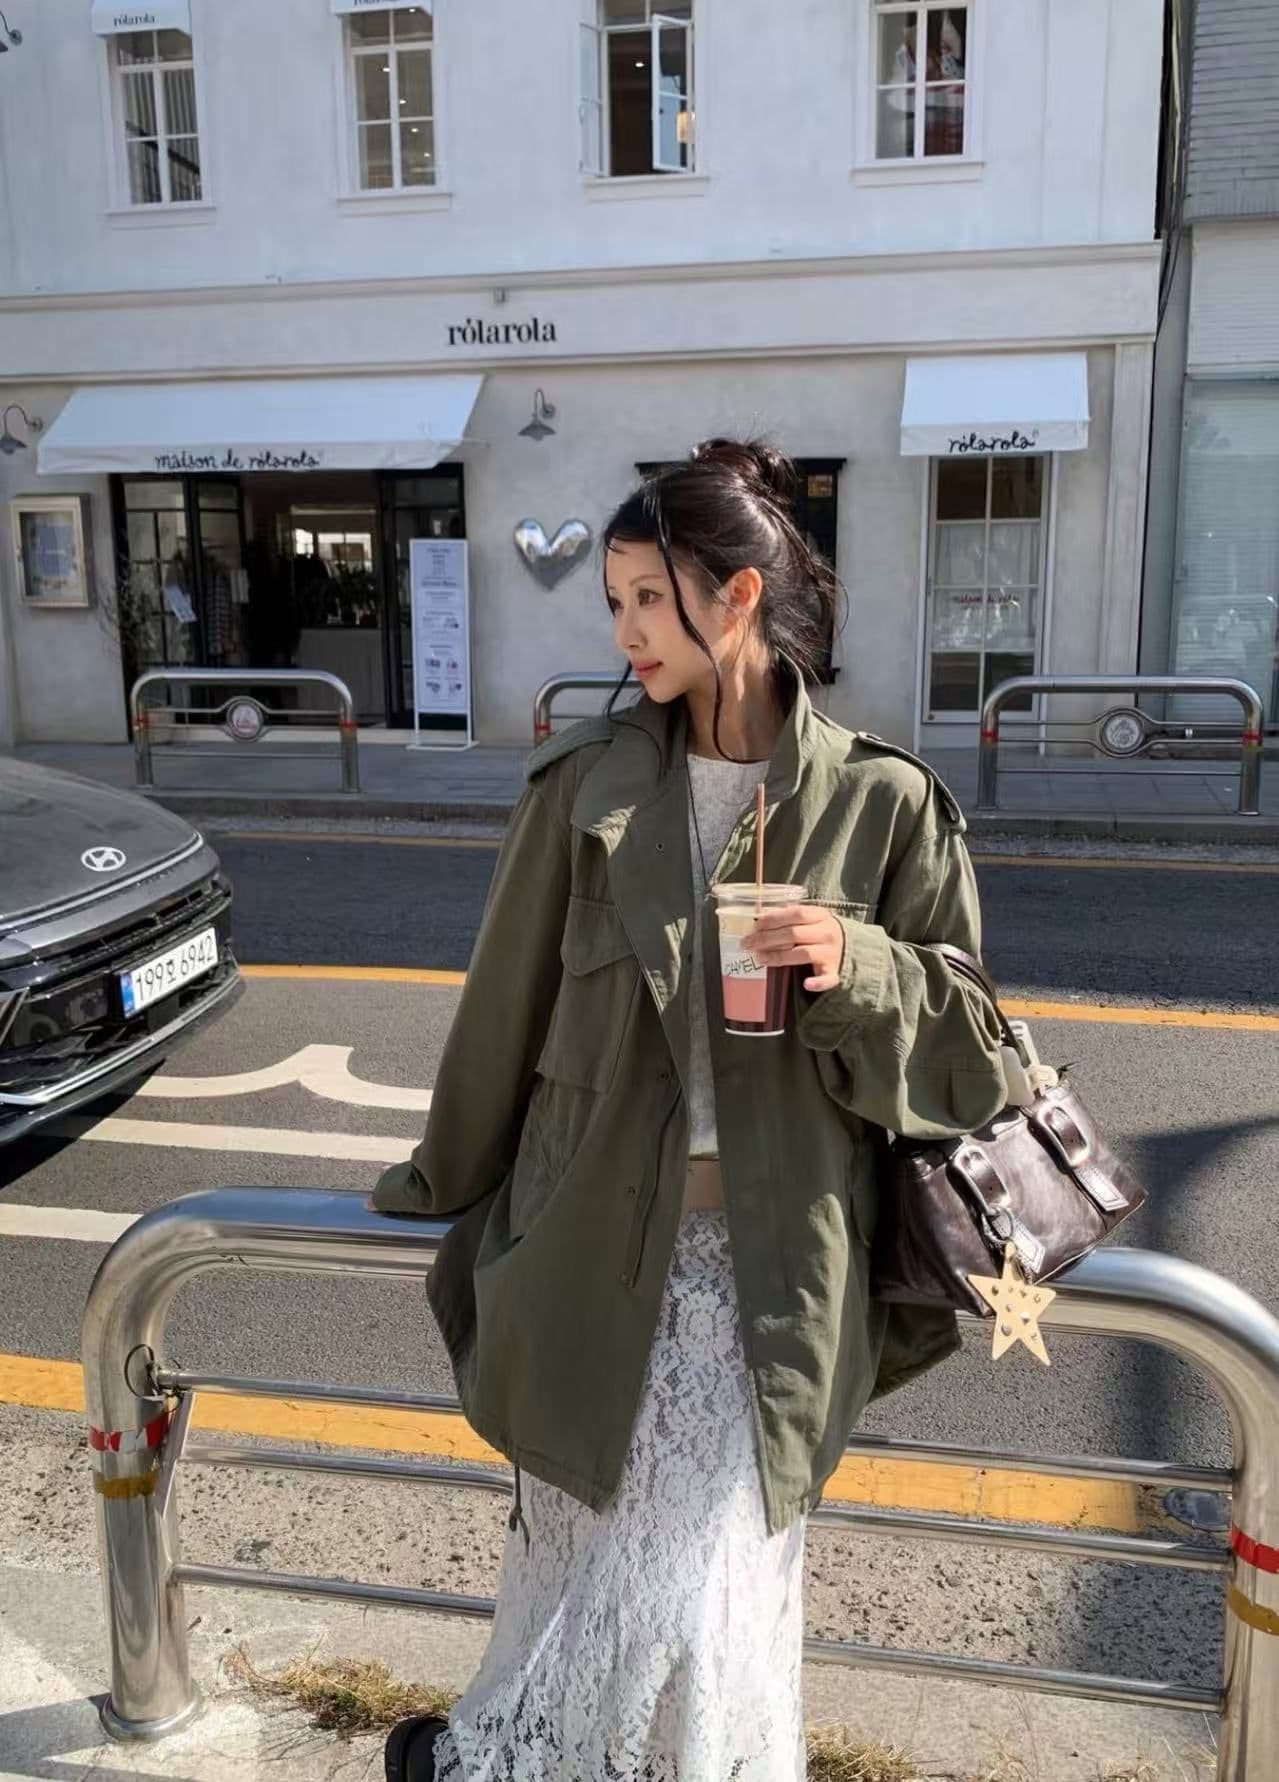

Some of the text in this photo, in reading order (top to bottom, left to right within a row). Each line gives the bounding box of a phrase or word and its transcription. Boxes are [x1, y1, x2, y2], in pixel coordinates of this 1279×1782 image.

[154, 450, 219, 469] maison
[221, 448, 244, 469] de
[180, 934, 215, 977] 6942
